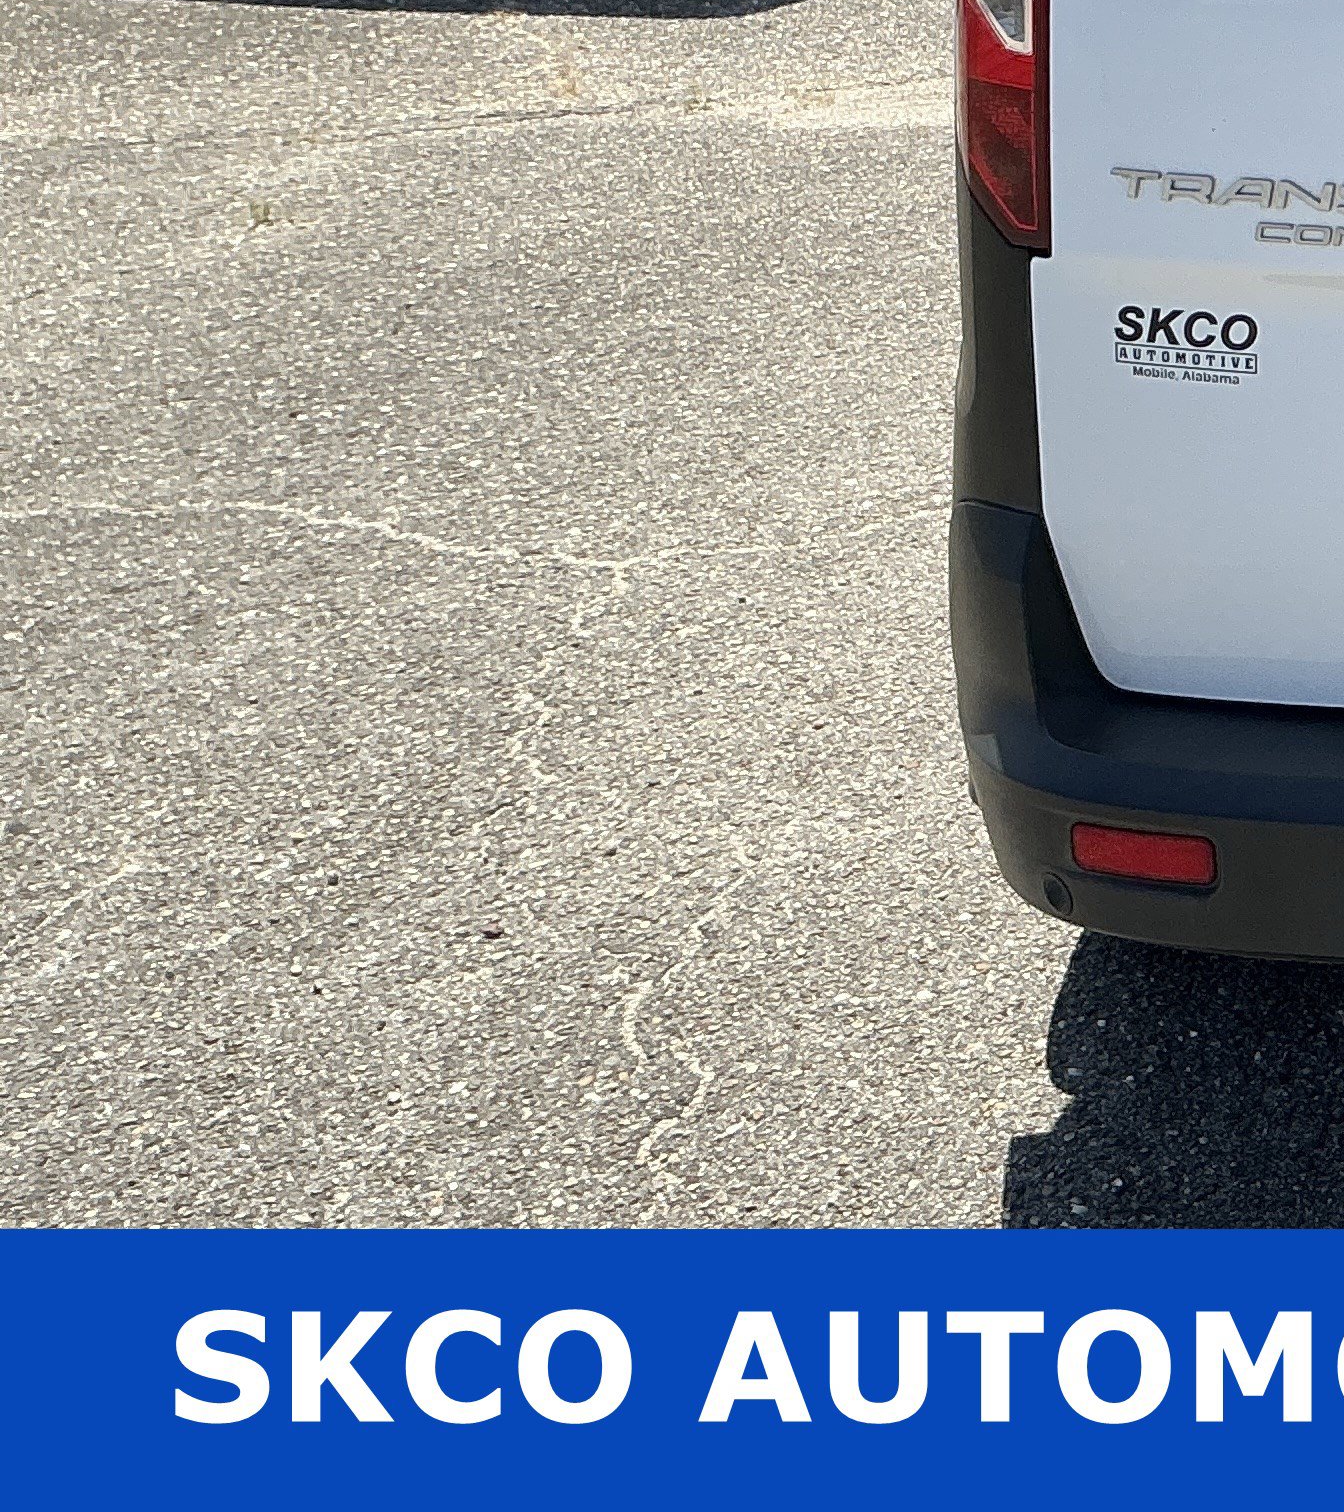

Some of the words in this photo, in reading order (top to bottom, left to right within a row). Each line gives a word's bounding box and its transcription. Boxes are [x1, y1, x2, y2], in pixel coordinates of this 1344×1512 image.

[1114, 305, 1258, 350] SKCO
[1119, 347, 1255, 370] AUTOMOTIVE
[1132, 366, 1179, 382] Mobile,
[1183, 370, 1240, 385] Alabama
